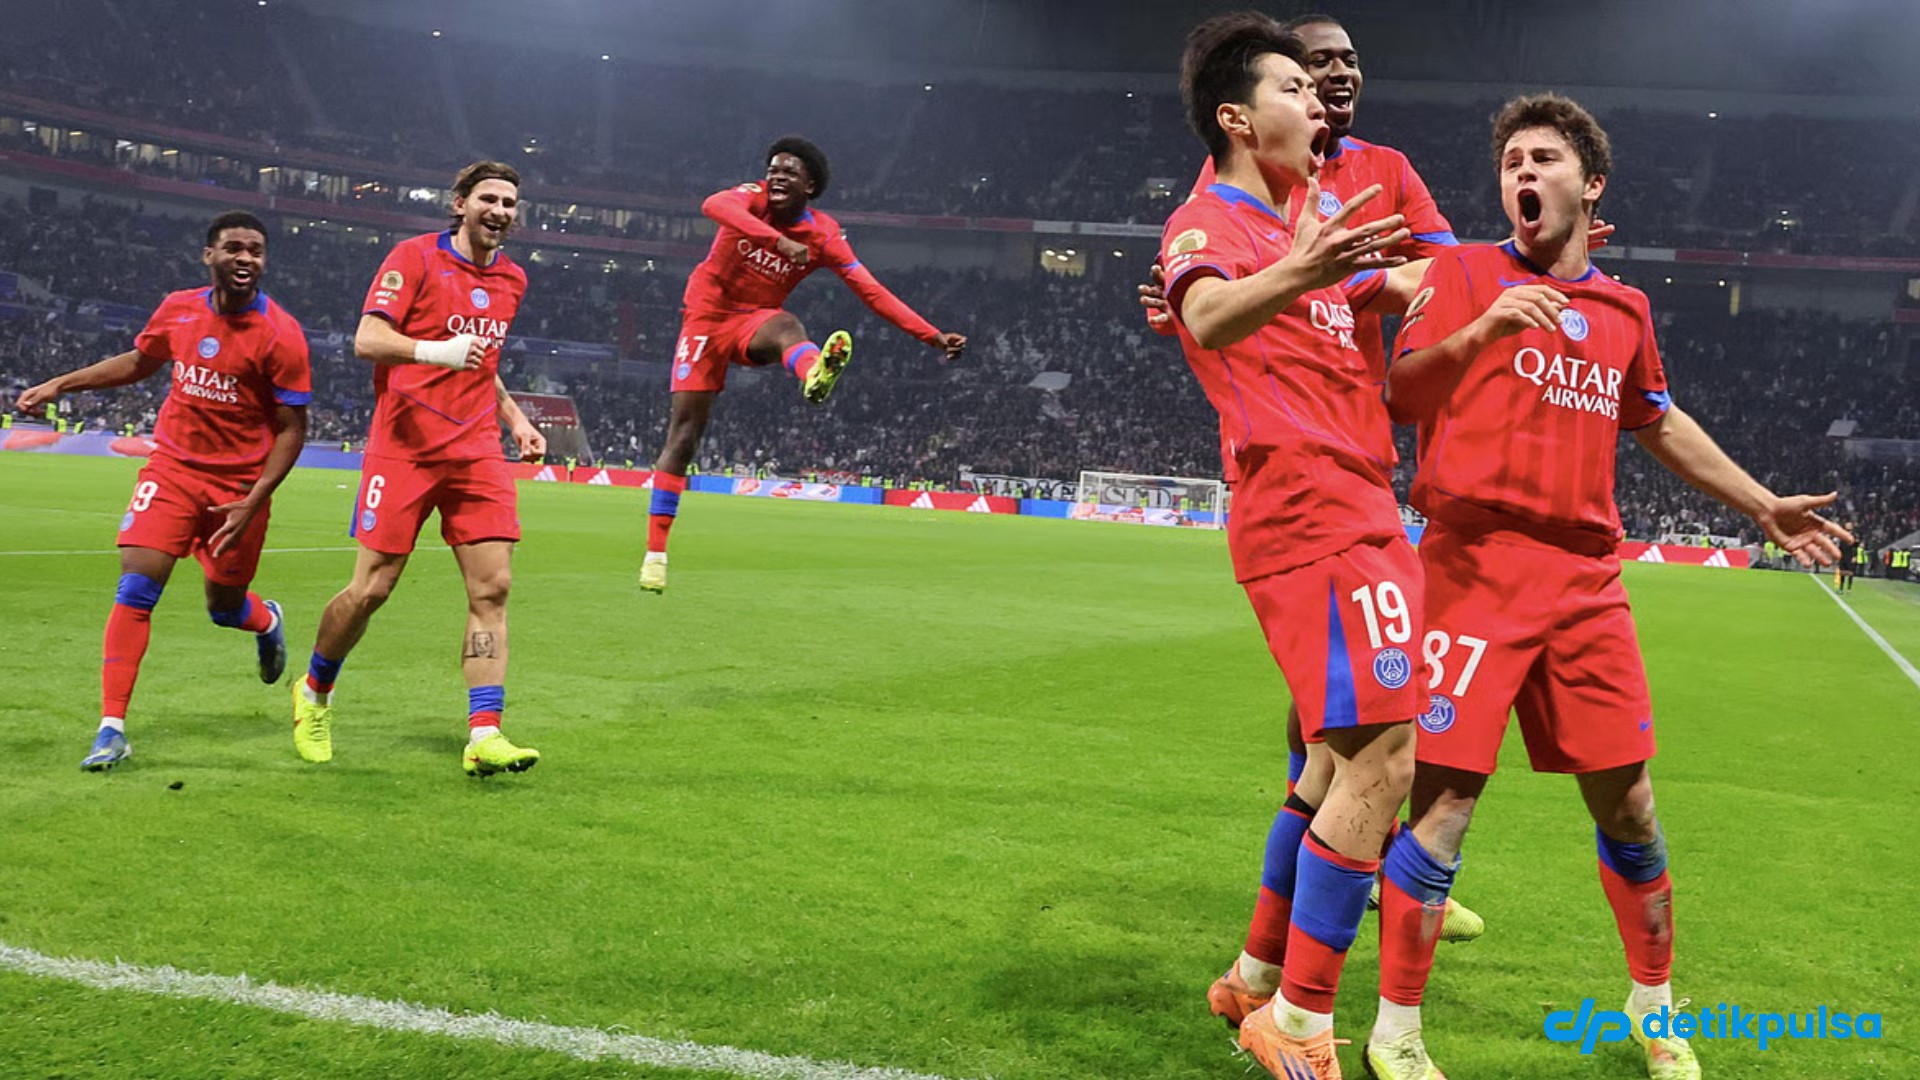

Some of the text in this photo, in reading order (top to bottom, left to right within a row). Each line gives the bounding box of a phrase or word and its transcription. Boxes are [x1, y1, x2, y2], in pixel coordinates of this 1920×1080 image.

[677, 335, 709, 363] 47
[1513, 346, 1622, 401] QATAR
[181, 382, 239, 404] AIRWAYS
[1541, 384, 1620, 421] AIRWAYS
[365, 474, 386, 509] 6
[1351, 580, 1412, 650] 19
[1422, 629, 1489, 698] 87
